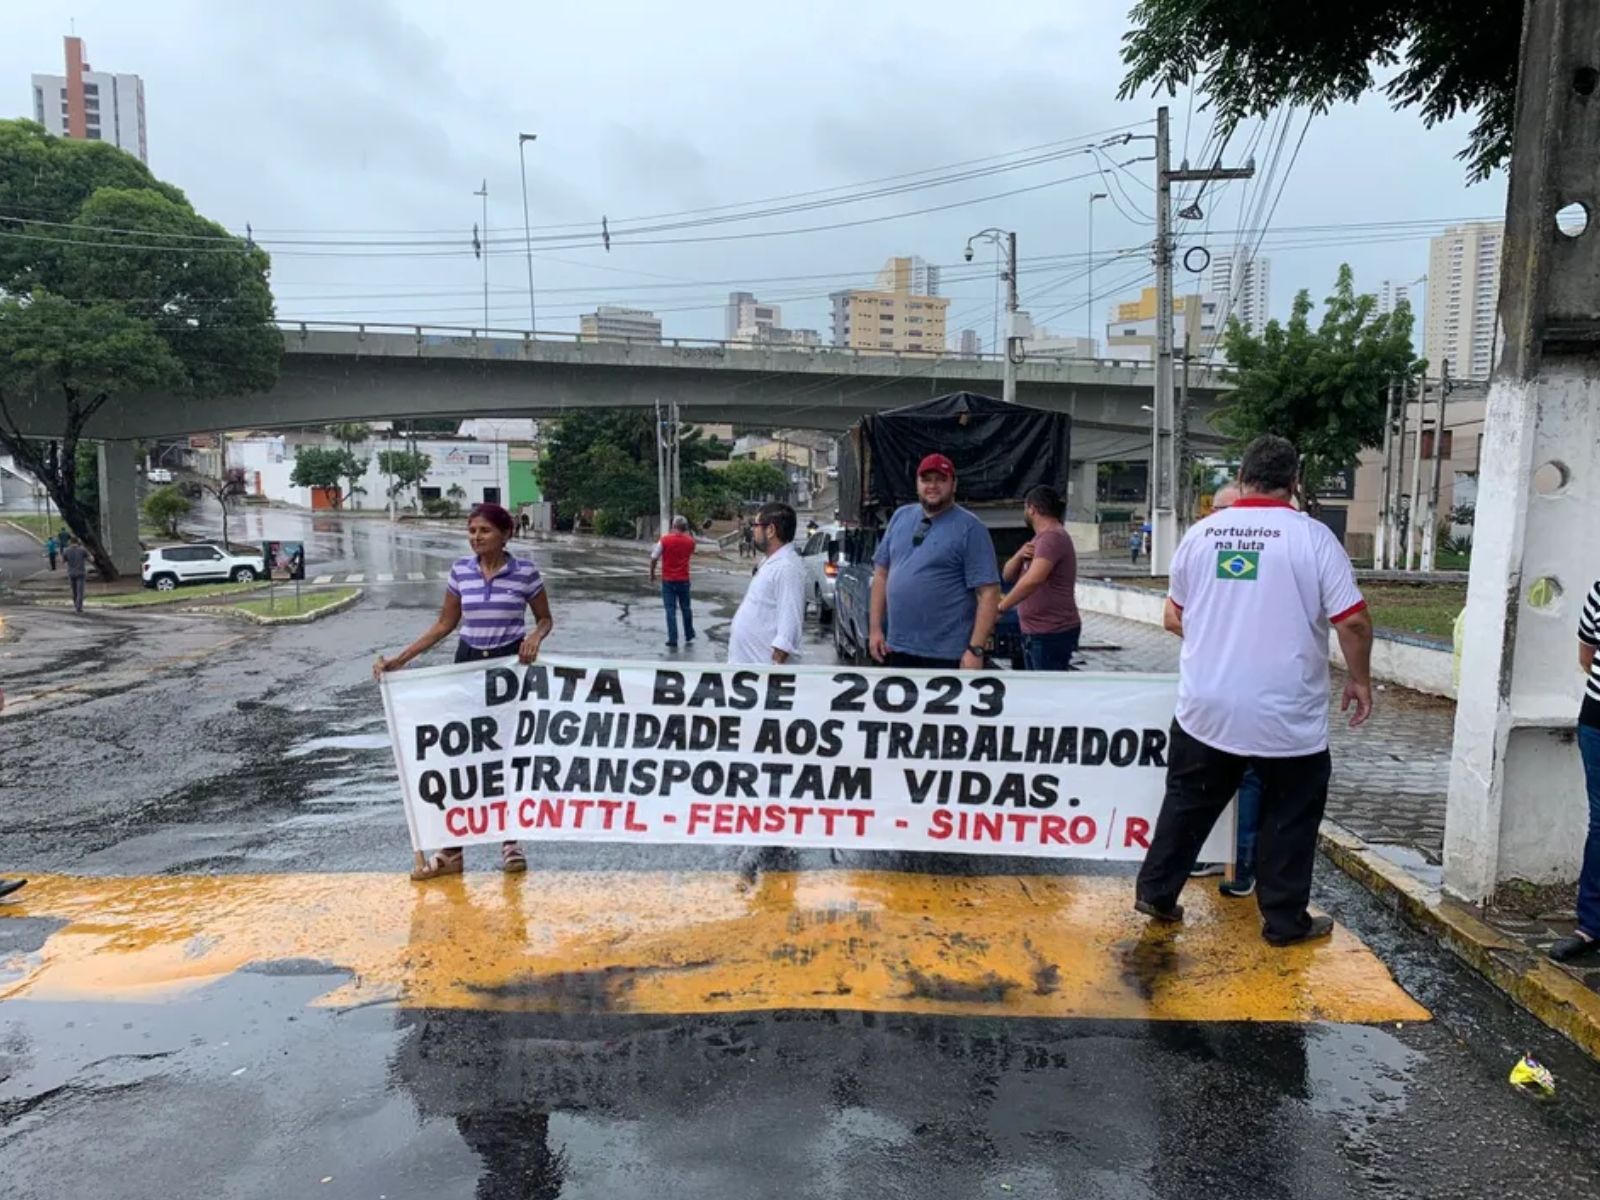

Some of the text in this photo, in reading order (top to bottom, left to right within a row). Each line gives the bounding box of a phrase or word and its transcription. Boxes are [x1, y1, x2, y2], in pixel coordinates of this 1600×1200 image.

[1204, 526, 1281, 538] Portuários
[1214, 539, 1265, 550] na luta
[485, 666, 1006, 717] DATA BASE 2023
[416, 715, 503, 761] POR
[514, 709, 741, 752] DIGNIDADE
[753, 718, 845, 758] AOS
[418, 755, 1081, 811] QUE TRANSPORTAM VIDAS.
[445, 800, 508, 837] CUT
[517, 797, 648, 833] CNTTL
[687, 802, 875, 837] FENSTTT
